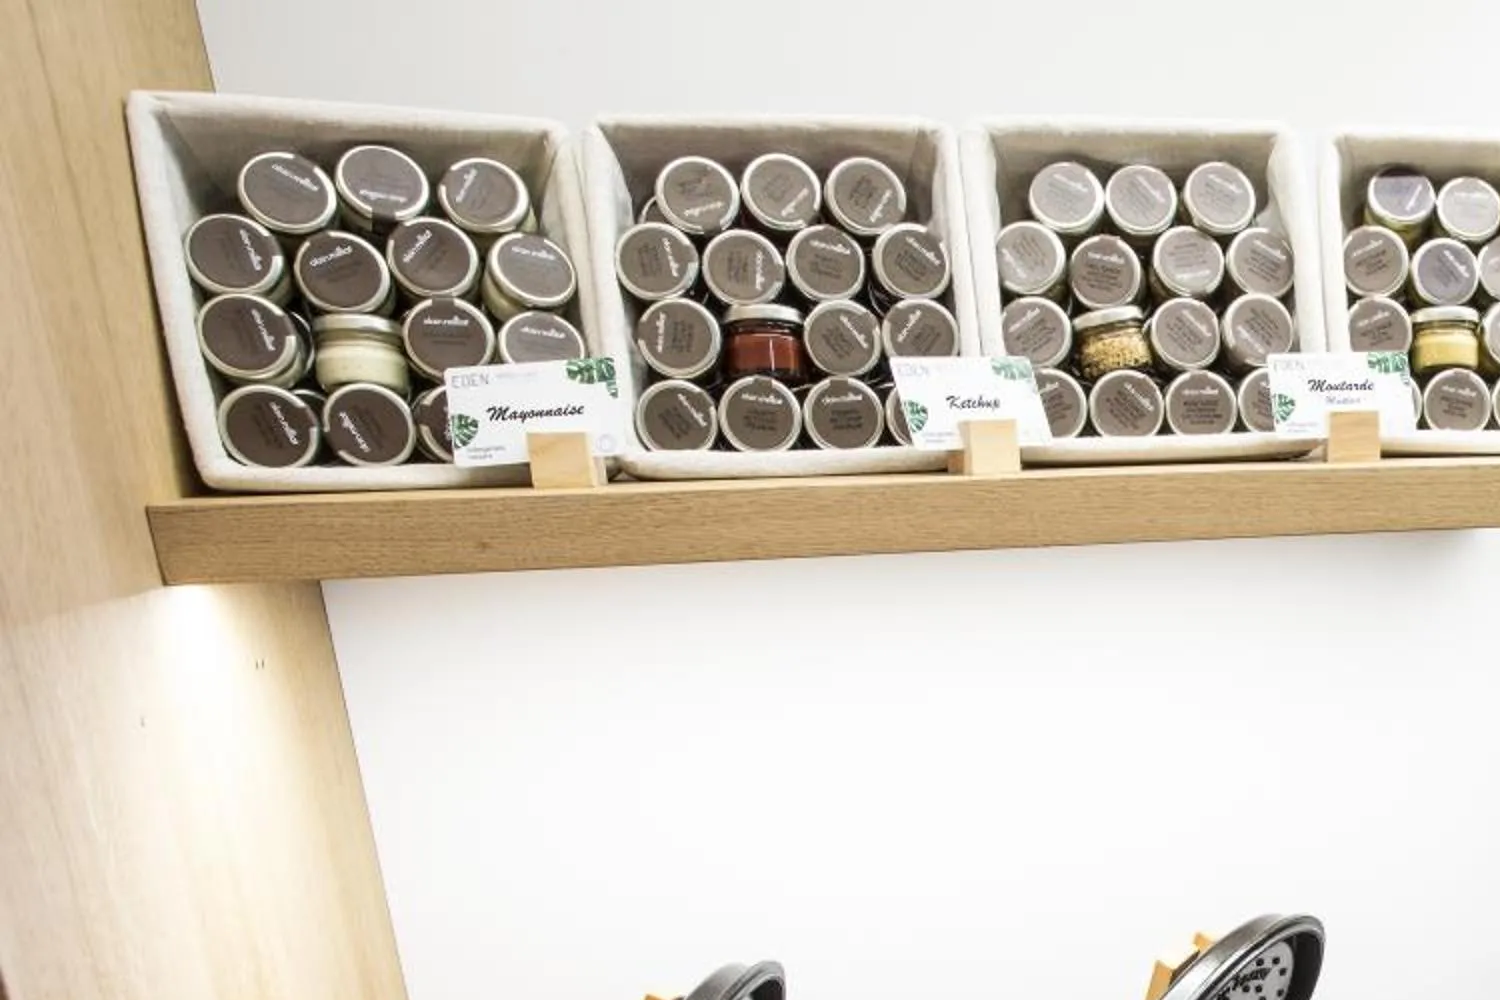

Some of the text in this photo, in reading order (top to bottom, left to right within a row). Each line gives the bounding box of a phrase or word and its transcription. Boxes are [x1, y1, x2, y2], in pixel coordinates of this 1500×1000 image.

[451, 373, 489, 389] EDEN
[1307, 379, 1375, 393] Moutarde
[945, 394, 1001, 411] Ketchup
[486, 403, 585, 424] Mayonnaise
